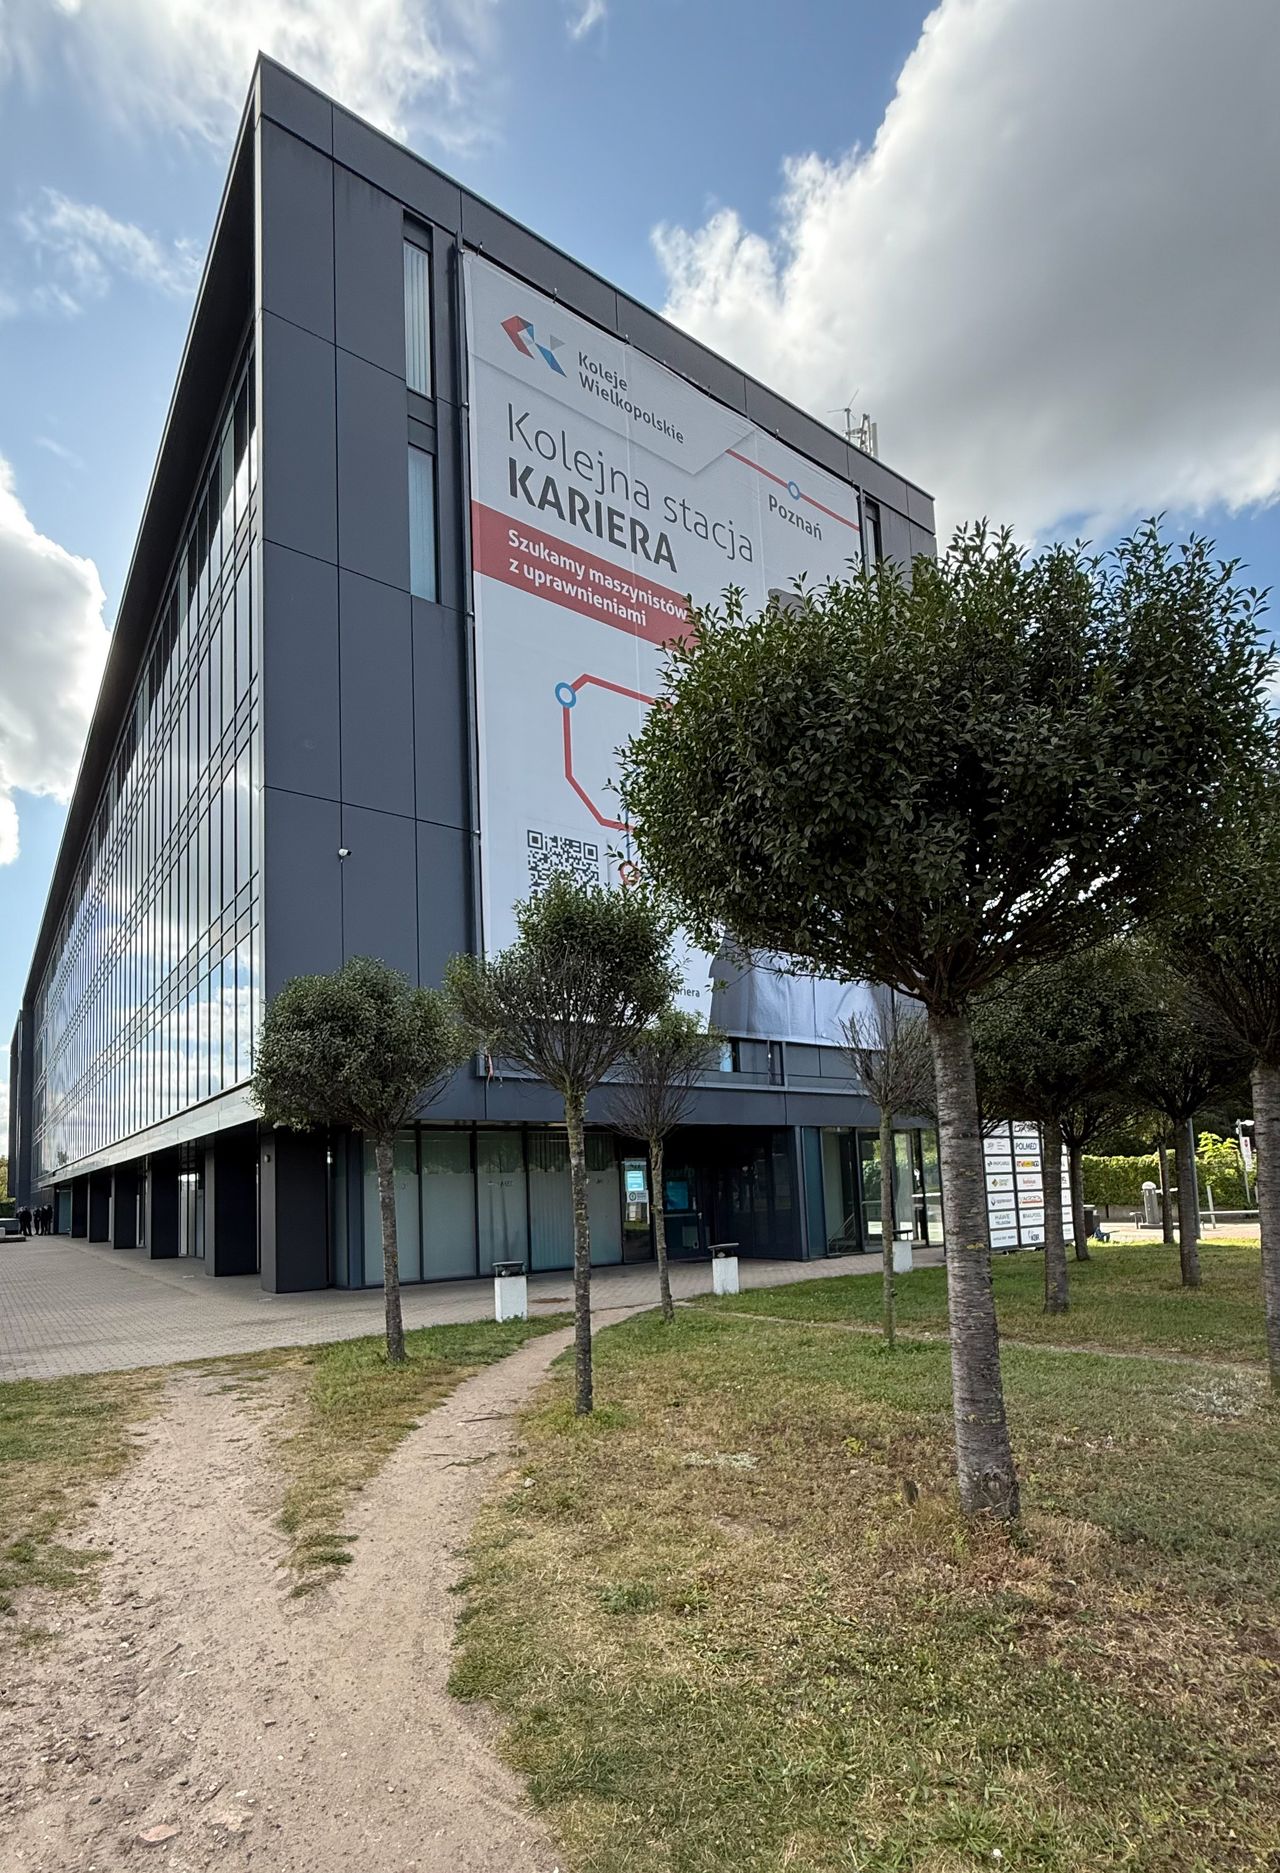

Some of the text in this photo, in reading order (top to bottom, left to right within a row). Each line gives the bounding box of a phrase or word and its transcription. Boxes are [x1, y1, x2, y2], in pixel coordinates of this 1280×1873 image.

[578, 351, 628, 392] Koleje
[579, 371, 685, 444] Wielkopolskie
[508, 402, 753, 562] Kolejna stacja
[508, 457, 678, 573] KARIERA
[768, 494, 822, 541] Poznań
[508, 529, 688, 621] Szukamy maszynistów
[509, 558, 647, 627] z uprawnieniami
